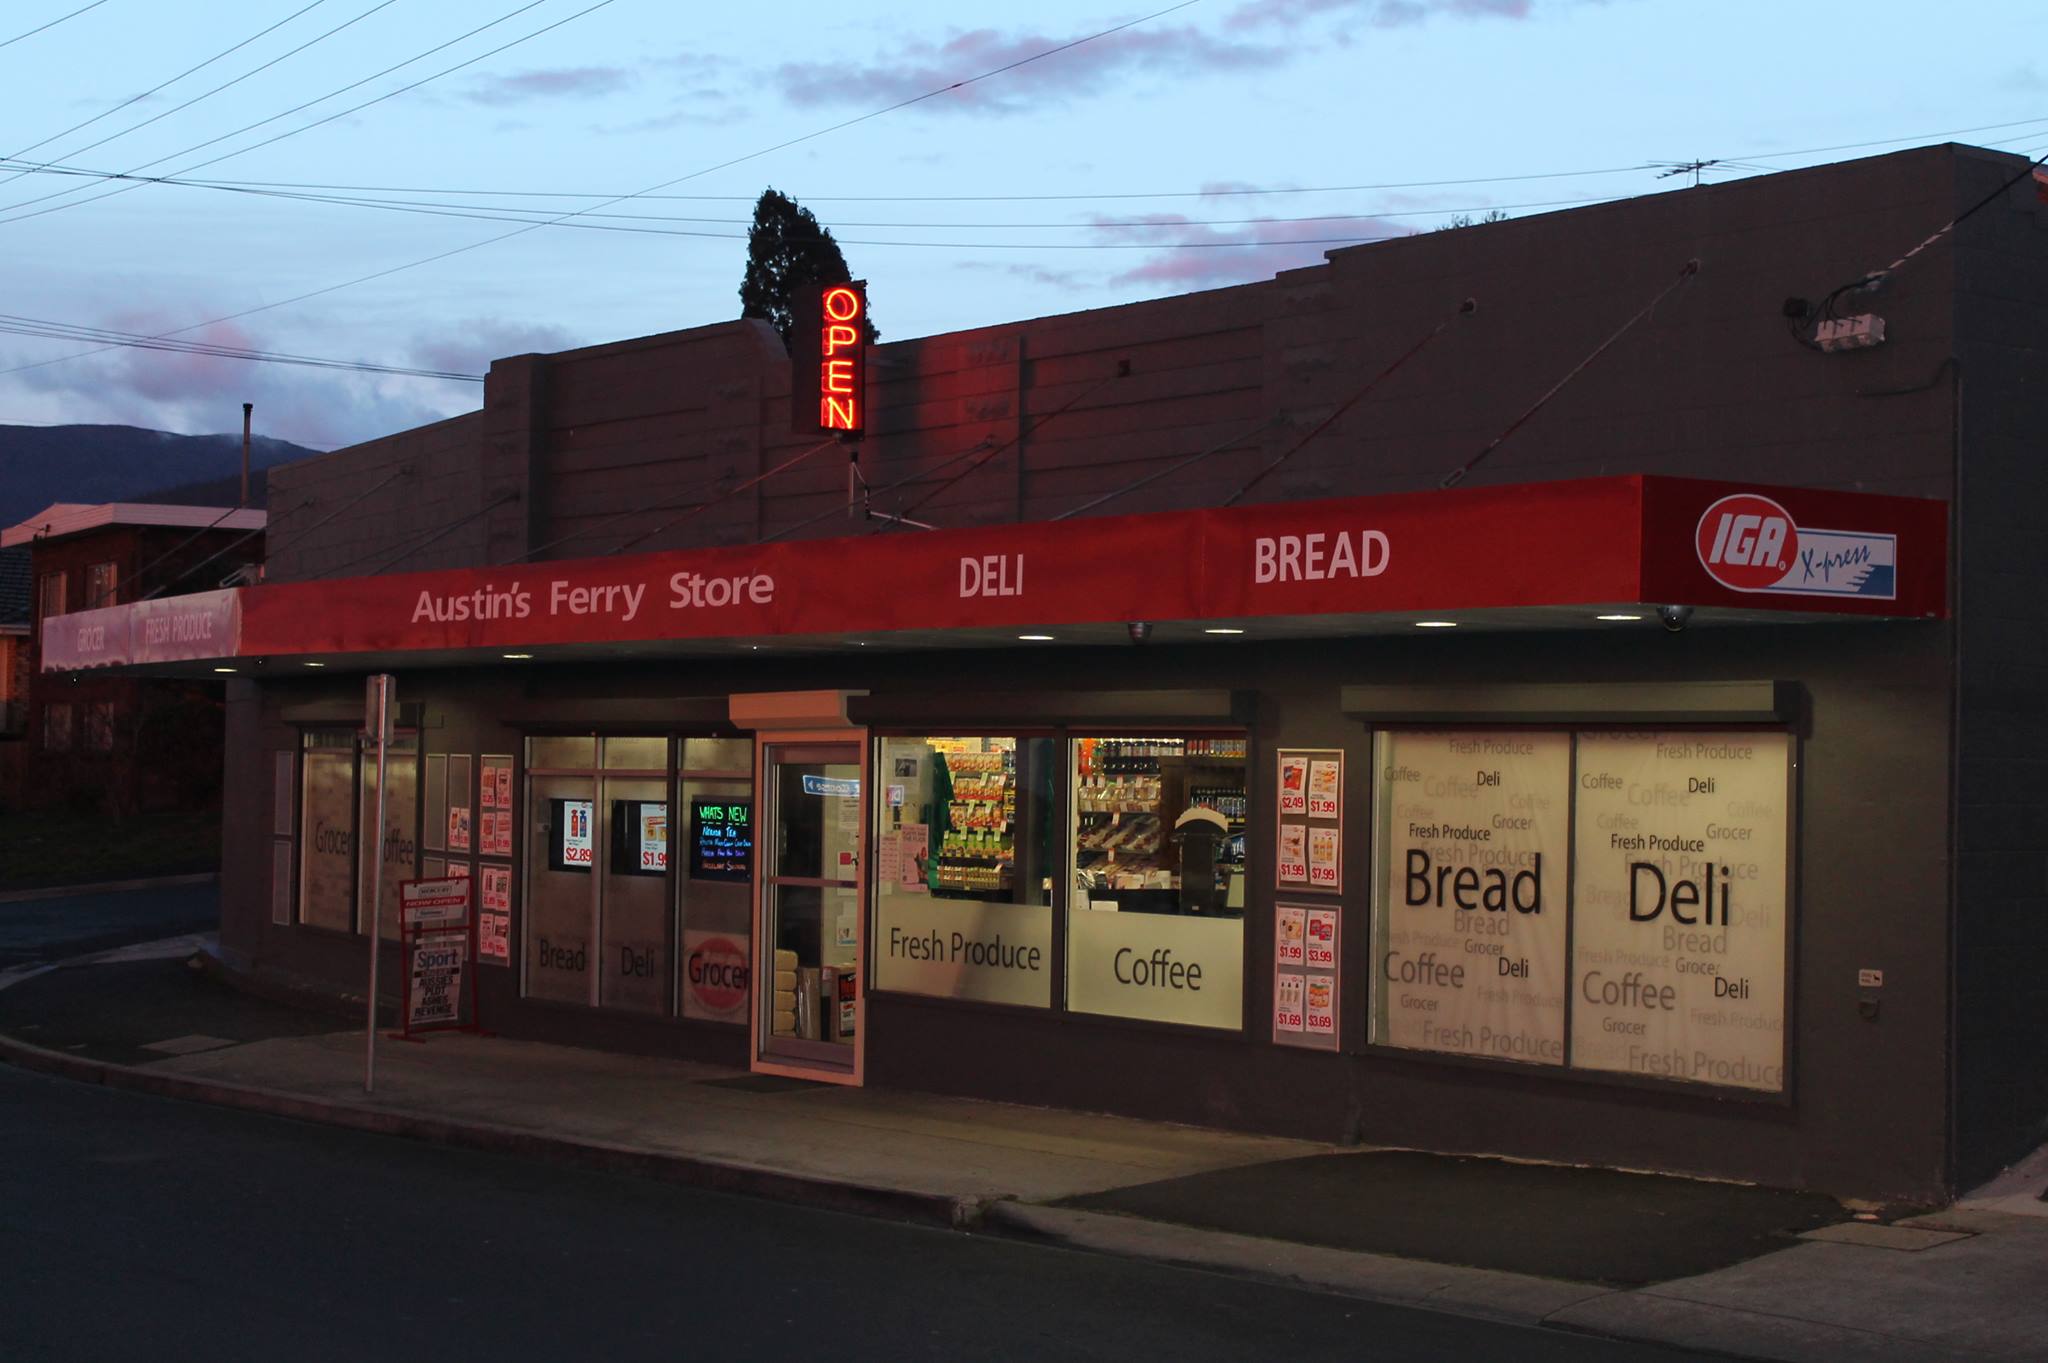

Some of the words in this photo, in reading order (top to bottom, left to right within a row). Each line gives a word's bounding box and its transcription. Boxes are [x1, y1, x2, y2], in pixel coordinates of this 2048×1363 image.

[824, 288, 859, 430] OPEN
[1708, 512, 1788, 568] IGA
[1255, 529, 1391, 584] BREAD
[1801, 545, 1871, 584] X-press
[959, 553, 1024, 598] DELI
[411, 581, 531, 623] Austin's
[549, 580, 646, 622] Ferry
[669, 571, 774, 609] Store
[145, 616, 170, 645] FRESH
[172, 611, 213, 642] PRODUCE
[77, 626, 105, 652] GROCER
[1449, 738, 1480, 754] Fresh
[1483, 739, 1534, 756] Produce
[1656, 743, 1693, 760] Fresh
[1696, 744, 1753, 761] Produce
[1384, 766, 1421, 783] Coffee
[1476, 770, 1501, 787] Deli
[1581, 773, 1624, 790] Coffee
[1688, 777, 1717, 795] Deli
[1282, 796, 1304, 809] $2.49
[1310, 800, 1336, 813] $1.99
[698, 805, 724, 821] WHATS
[727, 805, 748, 823] NEW
[1491, 813, 1534, 830] Grocer
[1409, 823, 1439, 839] Fresh
[1442, 824, 1491, 841] Produce
[1705, 822, 1753, 841] Grocer
[384, 828, 413, 865] offee
[565, 847, 592, 862] $2.89
[1610, 834, 1646, 851] Fresh
[1648, 834, 1706, 854] Produce
[1280, 863, 1305, 876] $1.99
[1311, 867, 1335, 880] $7.99
[1405, 848, 1542, 914] Bread
[405, 900, 432, 908] NOW
[432, 897, 462, 906] OPEN
[1630, 861, 1729, 926] Deli
[1453, 908, 1511, 937] Bread
[890, 927, 944, 962] Fresh
[951, 932, 1041, 971] Produce
[1464, 938, 1505, 955] Grocer
[1663, 924, 1729, 954] Bread
[418, 949, 458, 969] Sport
[539, 938, 586, 973] Bread
[621, 946, 655, 979] Deli
[1279, 945, 1302, 959] $1.99
[1308, 949, 1332, 962] $3.99
[688, 953, 750, 990] Grocer
[1114, 947, 1202, 991] Coffee
[1384, 950, 1466, 989] Coffee
[1498, 956, 1530, 979] Deli
[1582, 970, 1677, 1012] Coffee
[1713, 976, 1751, 1000] Deli
[1400, 993, 1440, 1011] Grocer
[1278, 1012, 1302, 1026] $1.69
[1602, 1016, 1648, 1036] Grocer
[1423, 1018, 1474, 1050] Fresh
[1479, 1025, 1564, 1059] Produce
[1629, 1044, 1687, 1077] Fresh
